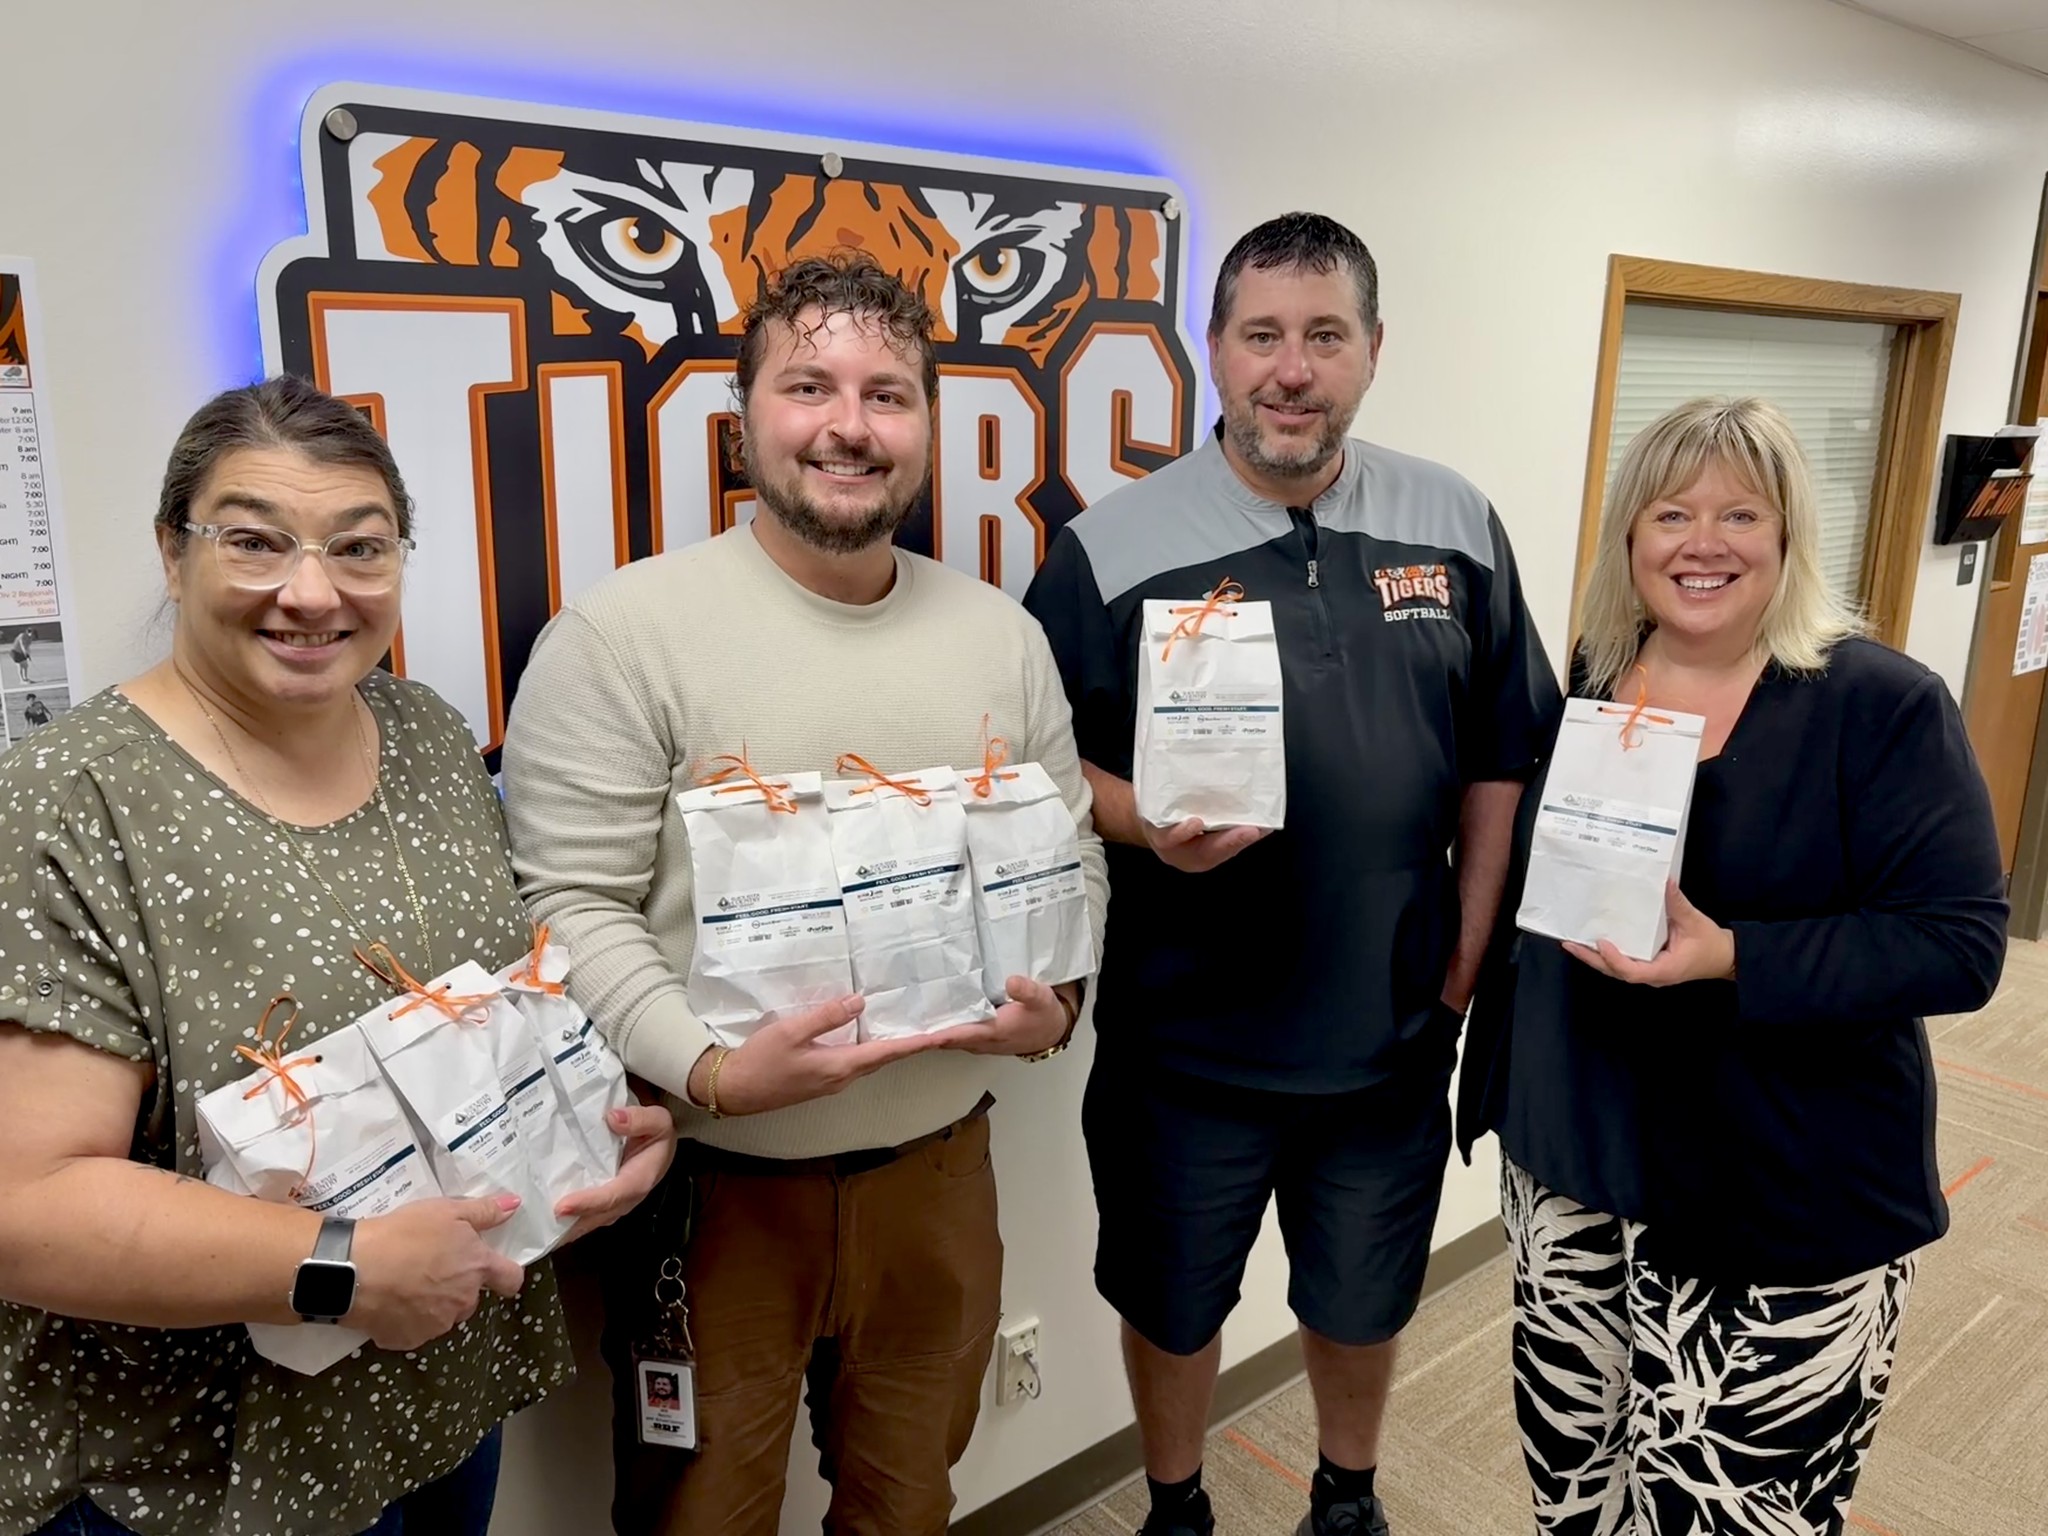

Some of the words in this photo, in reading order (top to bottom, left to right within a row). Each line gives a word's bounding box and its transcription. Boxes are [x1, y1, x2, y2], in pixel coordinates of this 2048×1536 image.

[20, 454, 38, 462] 7:00
[24, 490, 43, 499] 7:00
[308, 291, 1184, 757] TIGRS
[29, 528, 47, 536] 7:00
[34, 562, 51, 570] 7:00
[35, 579, 53, 587] 7:00
[1373, 574, 1450, 609] TIGERS
[1383, 607, 1451, 622] SOFTBALL
